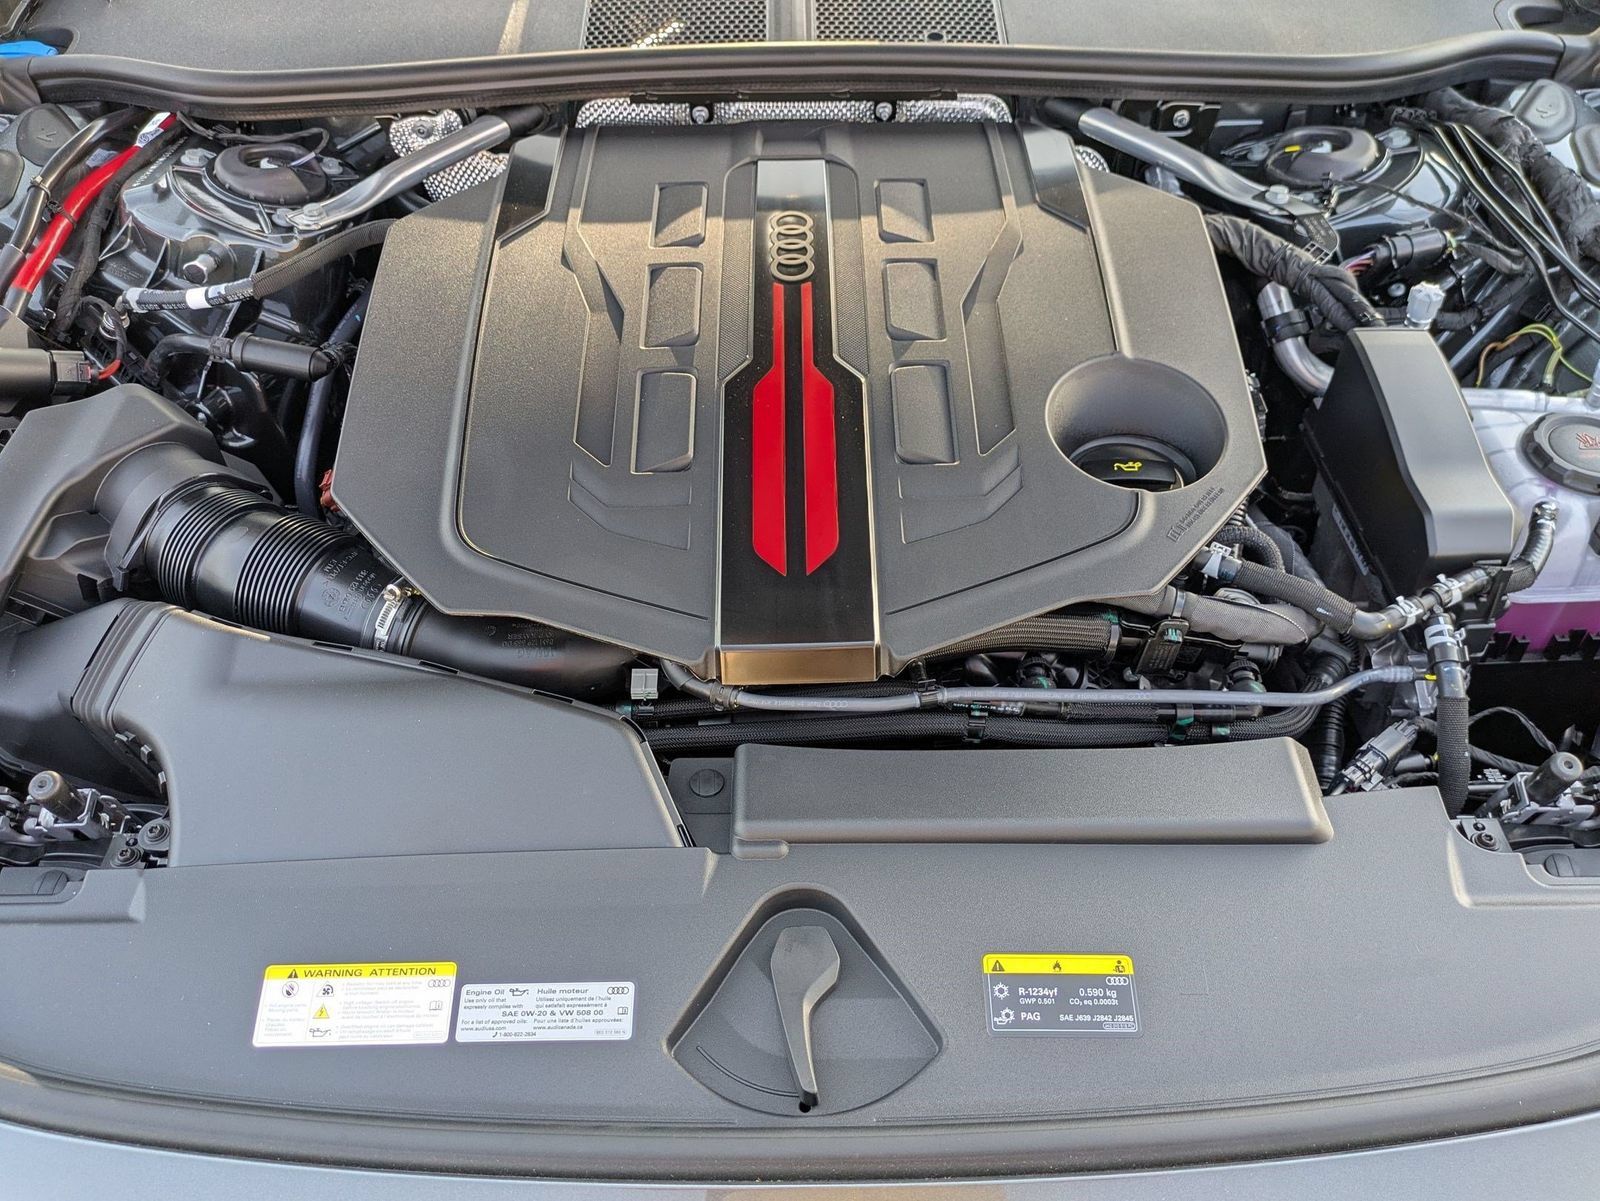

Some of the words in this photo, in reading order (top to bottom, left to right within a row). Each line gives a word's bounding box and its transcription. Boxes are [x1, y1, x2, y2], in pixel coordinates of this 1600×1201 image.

[303, 969, 363, 977] WARNING
[369, 967, 437, 976] ATTENTION
[1018, 987, 1058, 997] R-1234yf
[1079, 988, 1103, 996] 0.590
[1106, 988, 1117, 998] kg
[1021, 1012, 1041, 1020] PAG
